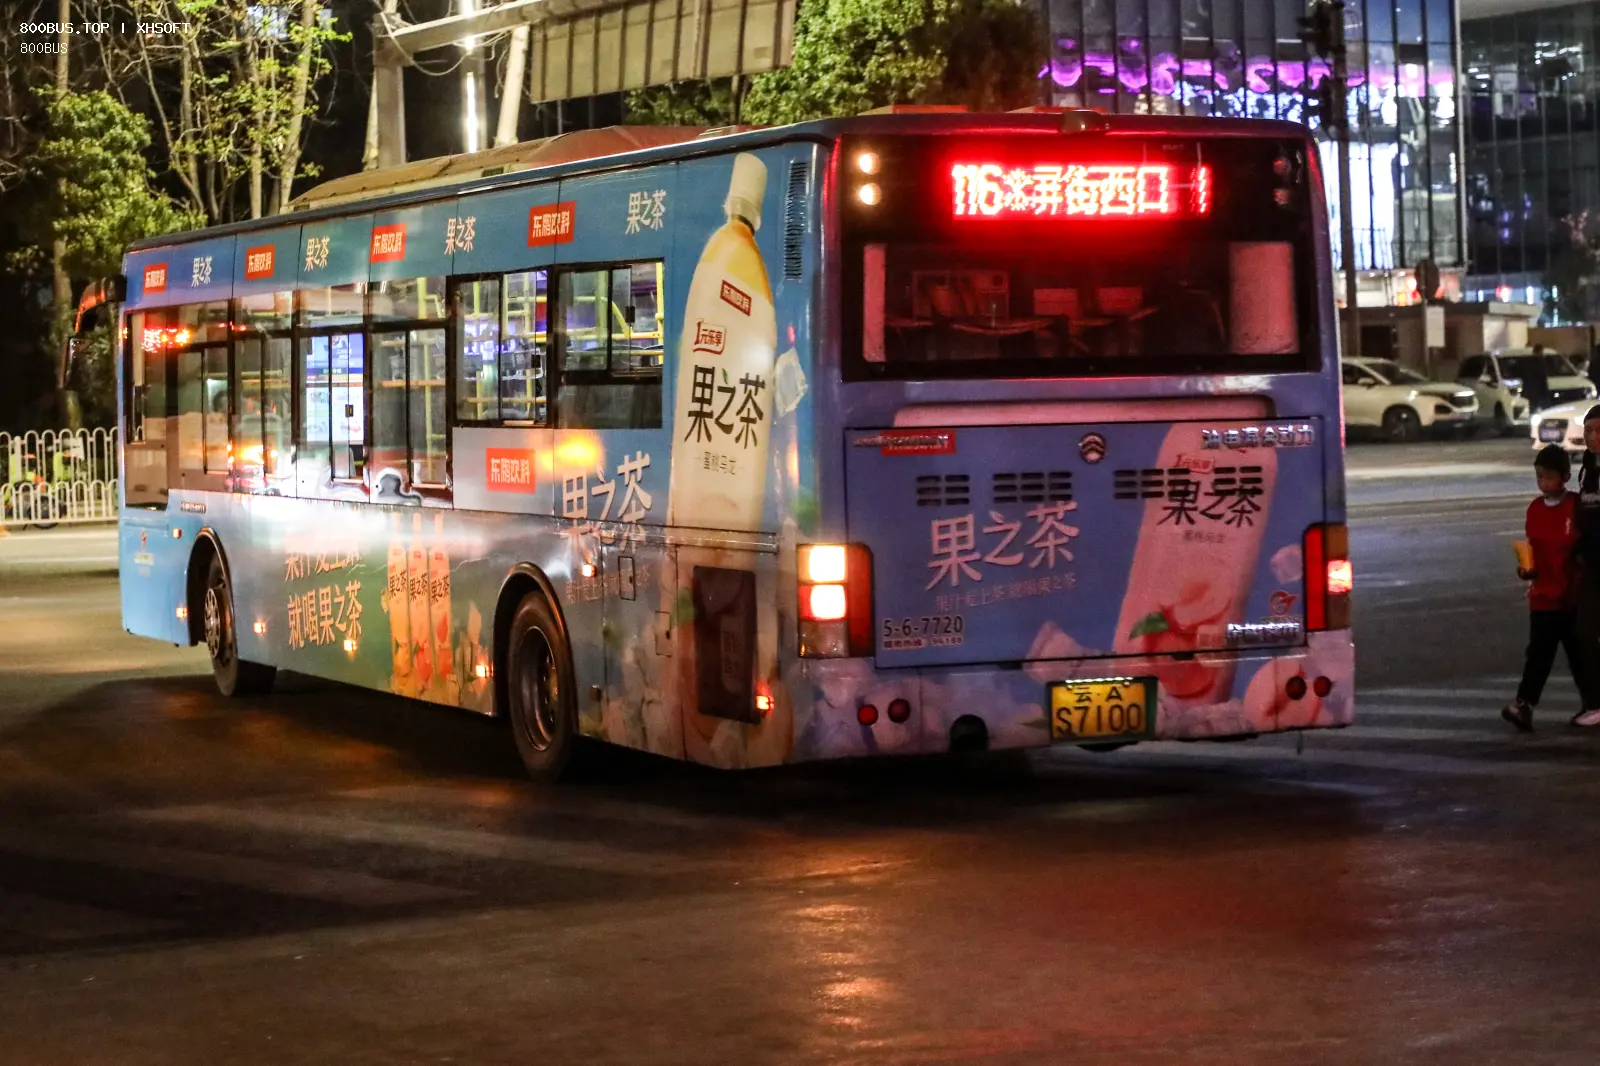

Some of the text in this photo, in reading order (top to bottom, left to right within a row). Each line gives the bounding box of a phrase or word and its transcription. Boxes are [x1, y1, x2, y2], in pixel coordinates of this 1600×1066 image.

[625, 189, 667, 235] 果之茶
[304, 237, 330, 272] 果之茶
[444, 216, 476, 255] 果之茶
[191, 256, 213, 288] 果之茶
[684, 364, 765, 450] 果之茶
[925, 500, 1080, 591] 果之茶
[287, 580, 363, 651] 就喝果之茶
[883, 616, 963, 637] 5-6-7720
[1056, 703, 1141, 737] S7100
